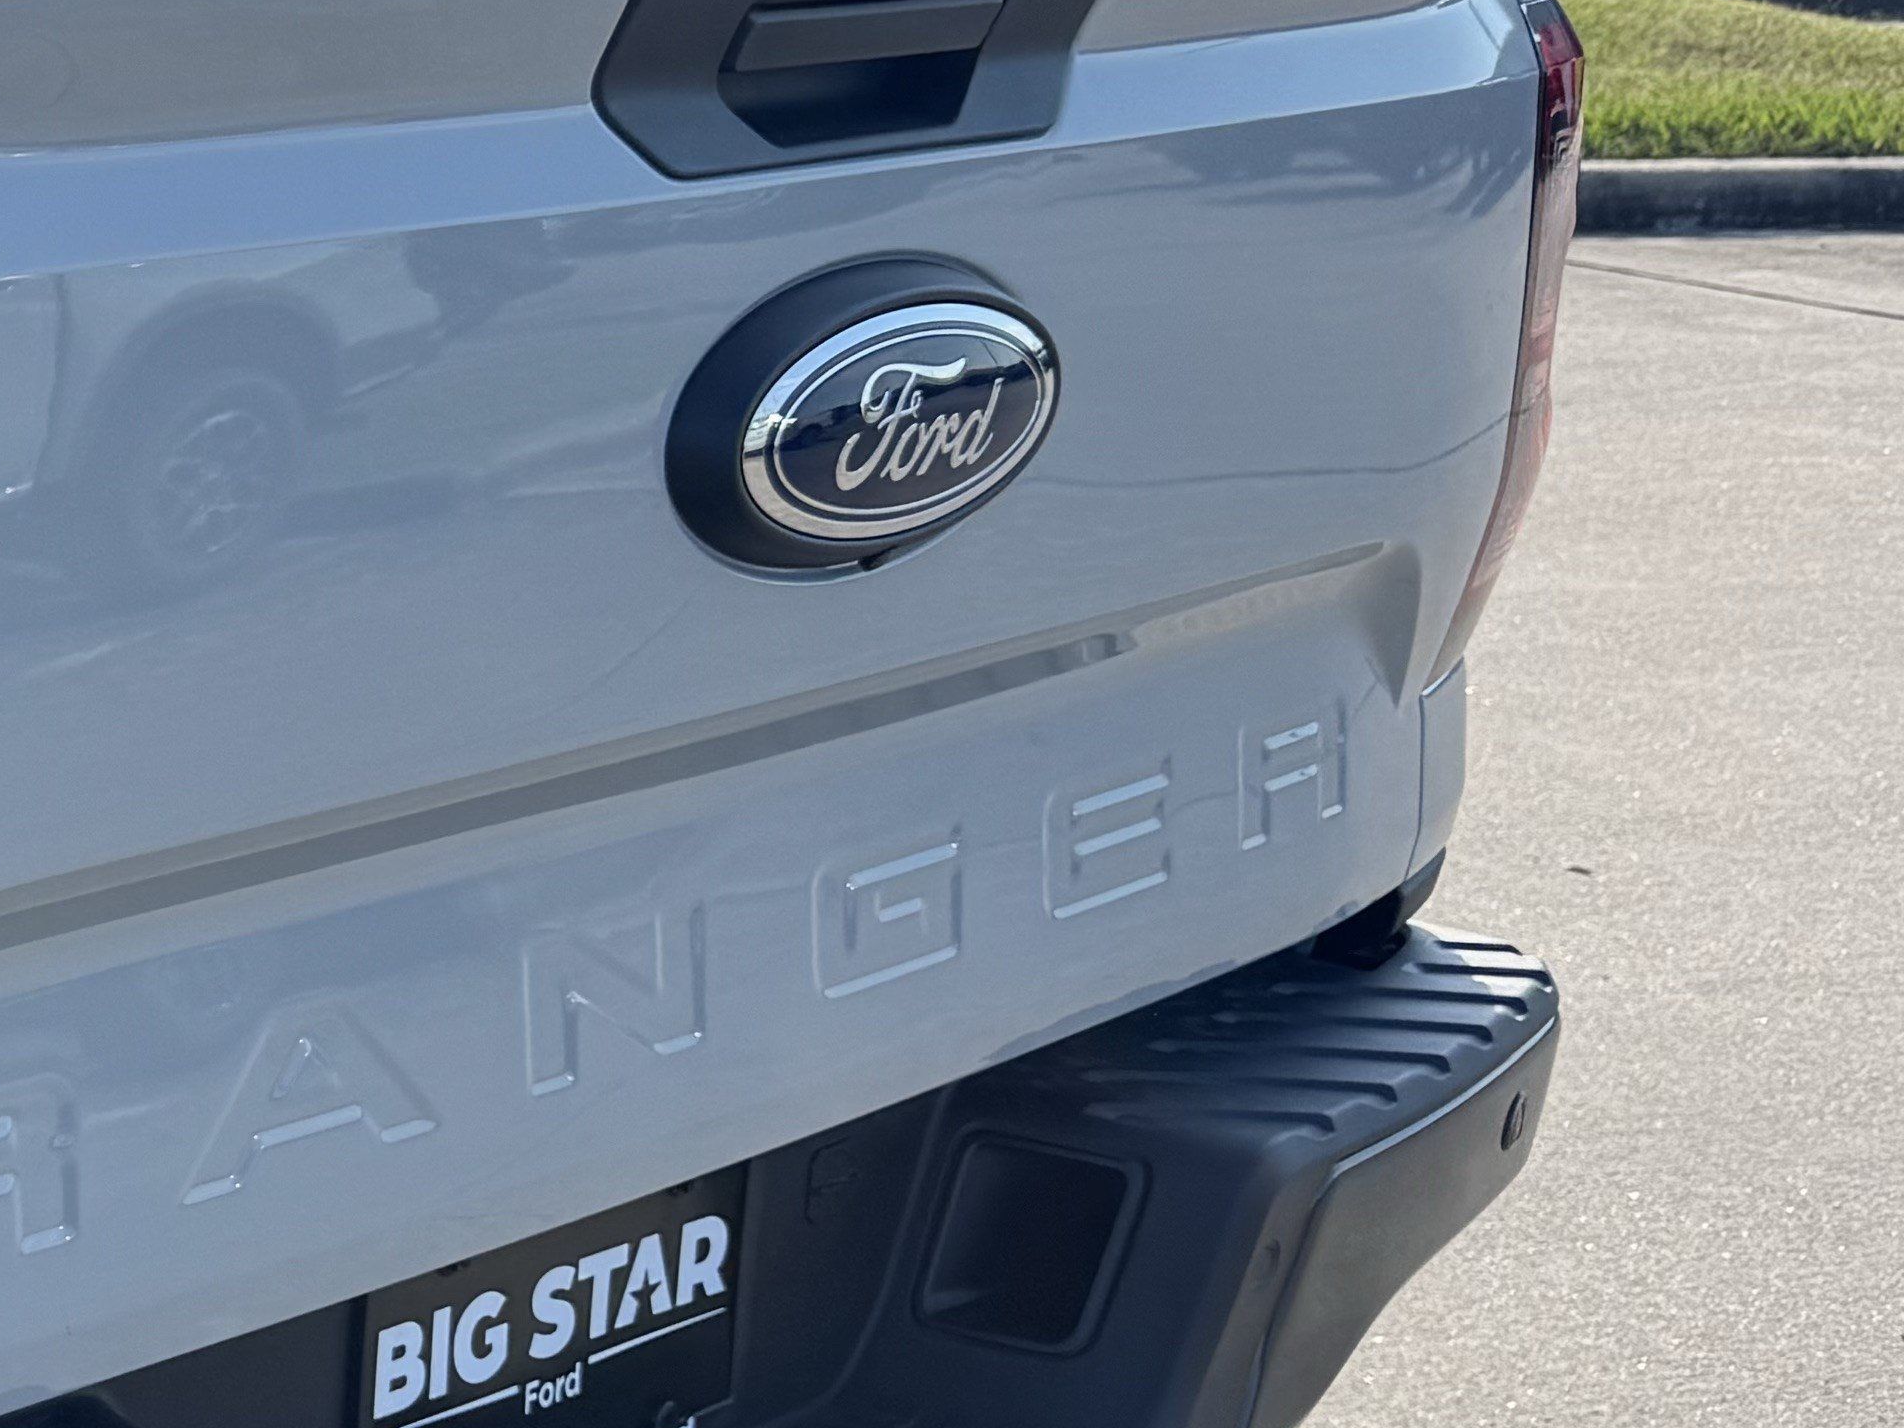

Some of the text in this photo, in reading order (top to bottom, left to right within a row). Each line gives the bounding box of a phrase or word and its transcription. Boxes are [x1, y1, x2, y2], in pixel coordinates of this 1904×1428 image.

[835, 356, 1005, 492] Ford
[372, 1214, 729, 1420] BIG STAR
[524, 1362, 583, 1416] Ford
